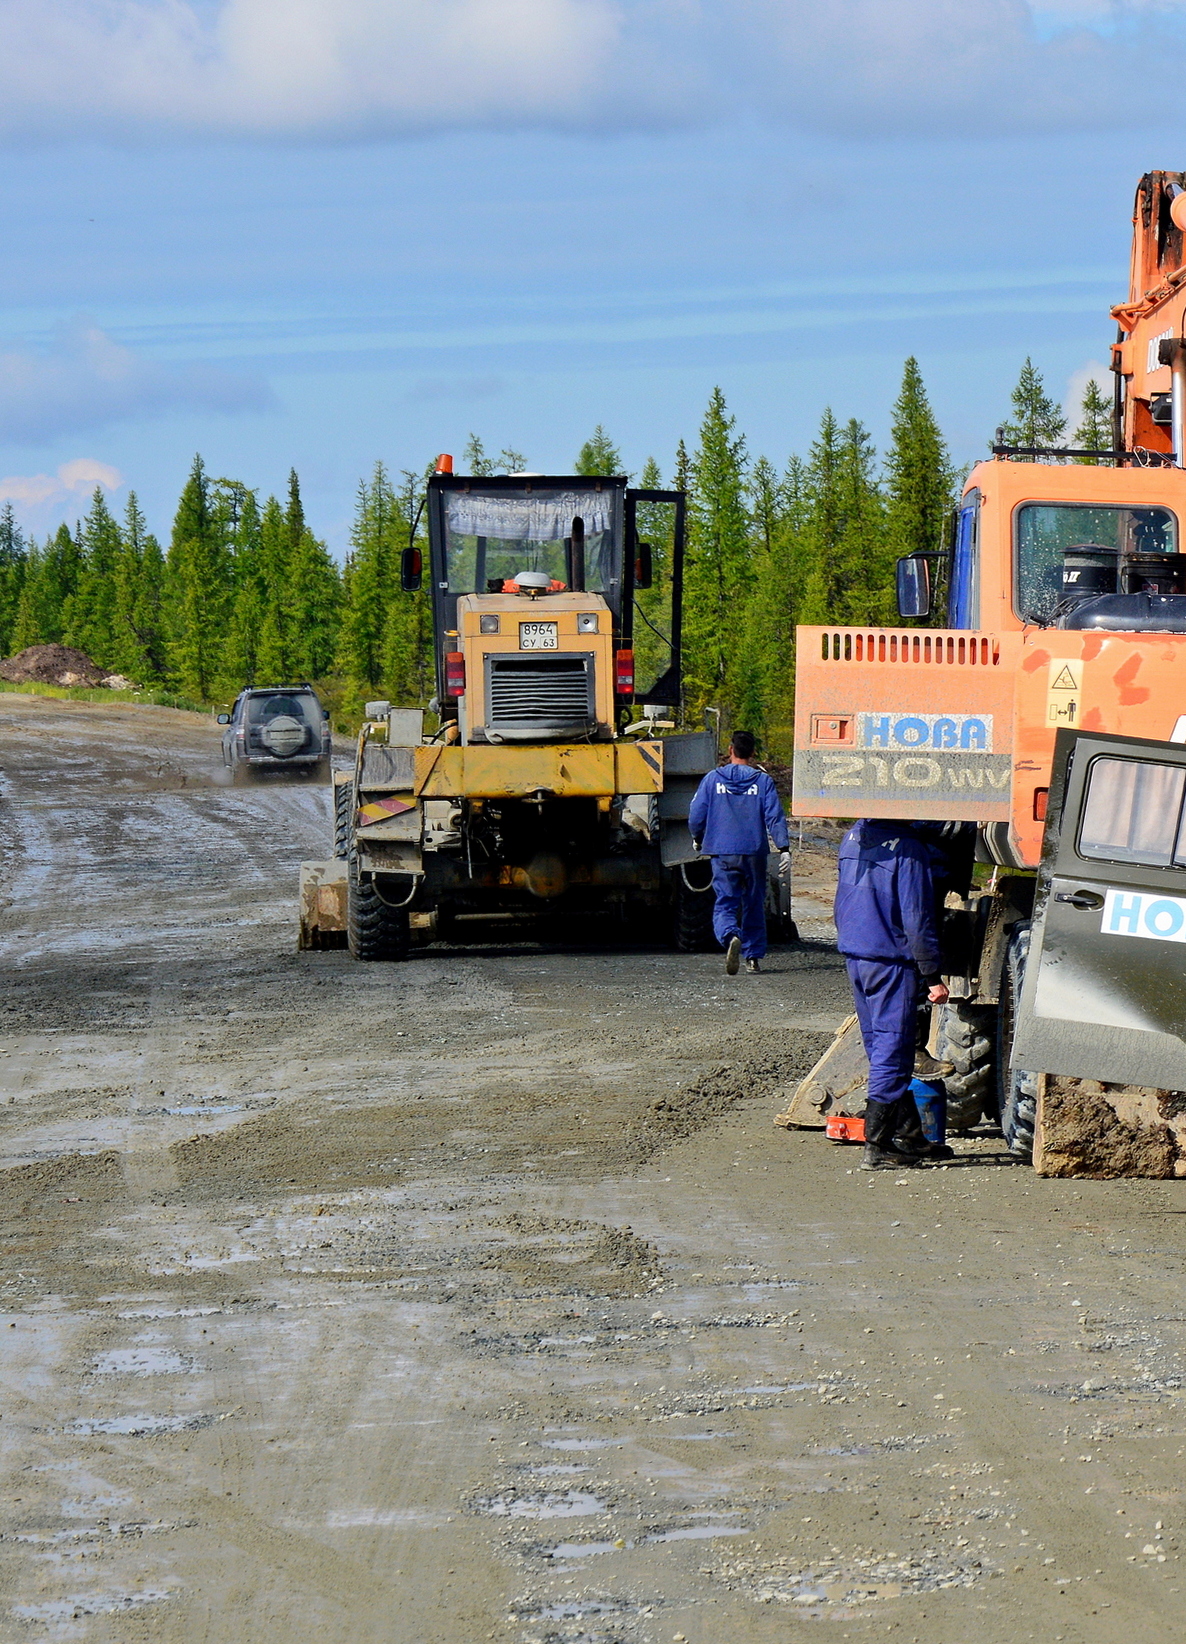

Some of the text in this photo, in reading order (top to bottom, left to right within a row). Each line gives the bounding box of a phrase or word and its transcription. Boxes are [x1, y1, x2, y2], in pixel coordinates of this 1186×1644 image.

[524, 624, 553, 635] 8964
[543, 638, 555, 648] 63
[863, 716, 986, 749] НОВА
